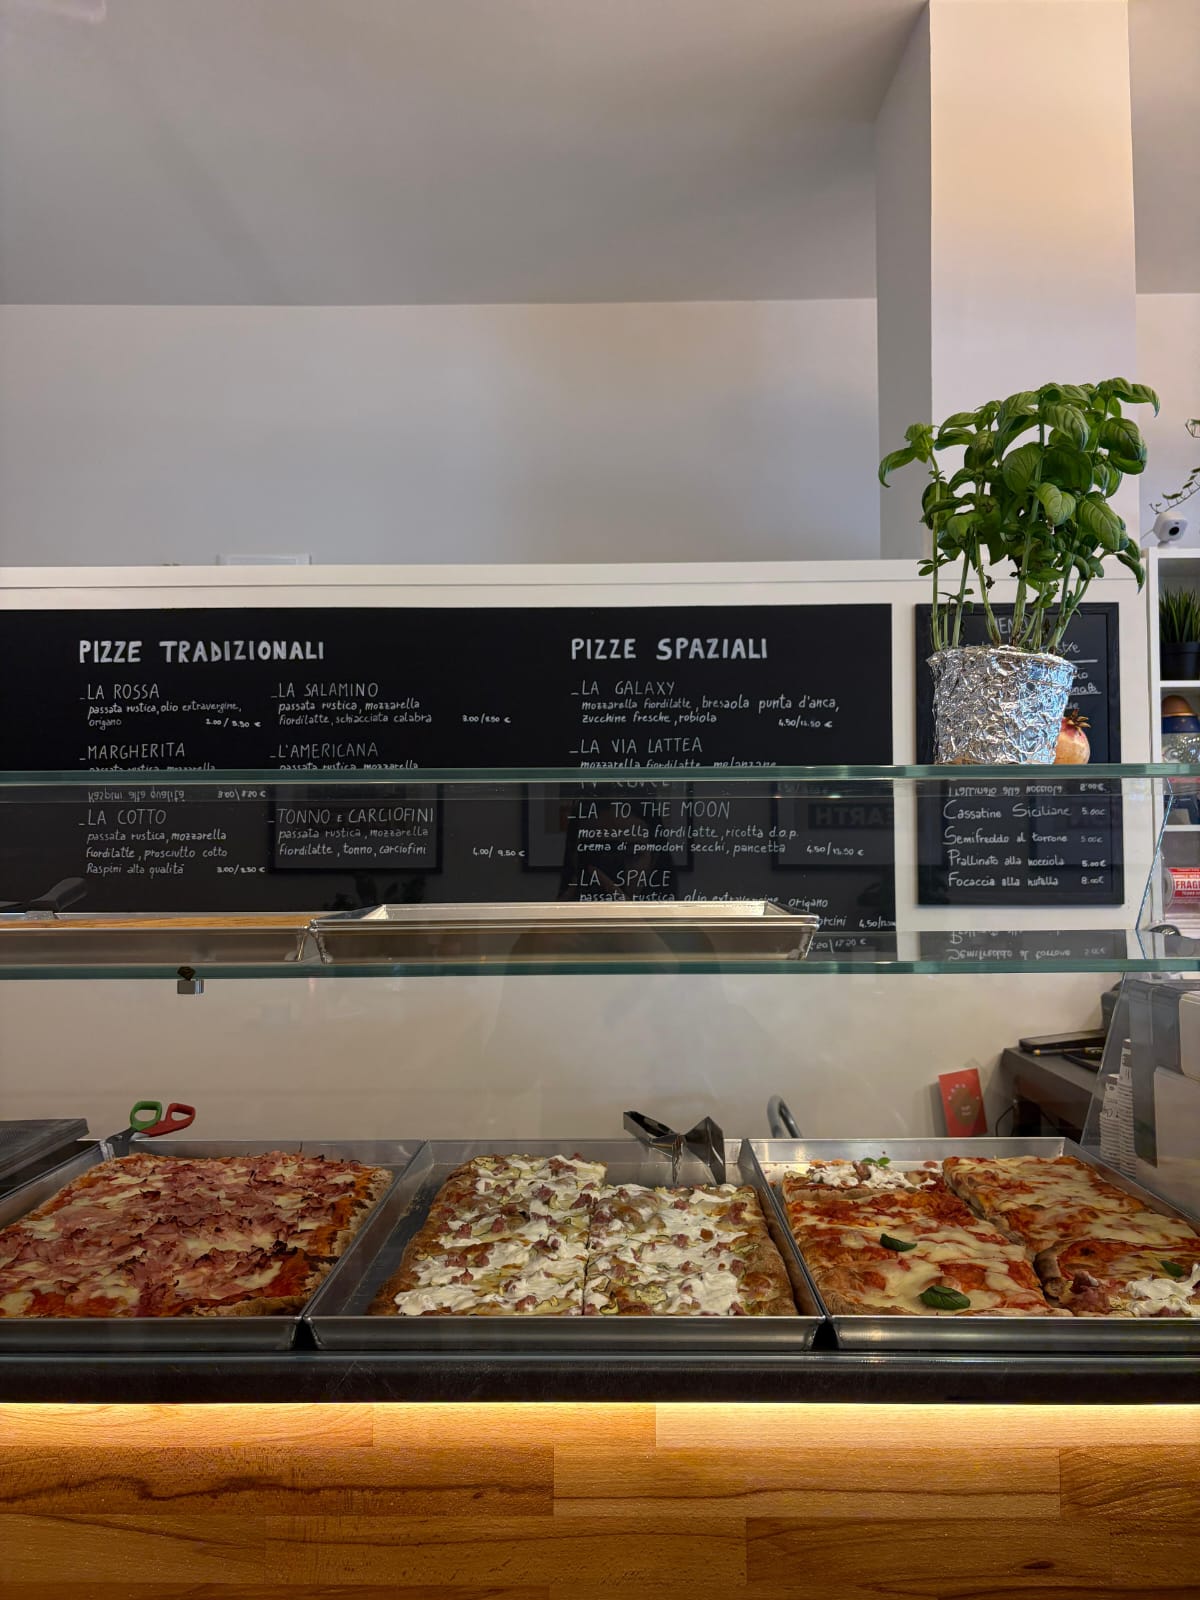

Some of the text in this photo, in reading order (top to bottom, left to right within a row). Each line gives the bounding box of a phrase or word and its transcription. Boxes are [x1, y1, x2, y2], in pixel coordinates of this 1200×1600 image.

[79, 640, 324, 663] PIZZE TRADIZIONALI
[571, 638, 768, 660] PIZZE SPAZIALI
[114, 683, 160, 699] ROSSA
[304, 682, 379, 698] SALAMINO
[615, 680, 675, 695] GALAXY
[88, 702, 123, 719] passata
[161, 702, 178, 712] olio
[279, 701, 316, 714] passata
[365, 699, 420, 710] mozzarella
[582, 697, 637, 710] mozzarella
[702, 695, 749, 709] bresaola
[758, 694, 792, 713] punta
[89, 717, 122, 730] origano
[335, 712, 389, 725] schiacciata
[394, 712, 432, 723] calabra
[582, 713, 627, 724] zucchine
[679, 710, 717, 723] robiola
[612, 739, 637, 753] VIA
[648, 737, 703, 754] LATTEA
[117, 809, 167, 825] COTTO
[348, 807, 434, 823] CARCIOFINI
[611, 802, 631, 818] TO
[640, 801, 671, 818] THE
[681, 800, 731, 819] MOON
[943, 799, 1002, 820] Cassatine
[1012, 803, 1072, 818] Siciliane
[86, 831, 126, 844] passata
[171, 828, 227, 841] mozzarella
[278, 827, 319, 844] passata
[370, 826, 429, 838] mozzarella
[578, 826, 649, 839] mozzarella
[726, 825, 763, 838] ricotta
[943, 826, 1010, 846] Semifreddo
[1016, 831, 1027, 842] al
[1032, 834, 1068, 842] torrone
[144, 847, 196, 860] prosciutto
[202, 847, 228, 857] cotto
[379, 843, 426, 855] carciofini
[577, 843, 611, 852] crema
[617, 841, 627, 851] di
[633, 841, 685, 854] pomodori
[733, 841, 786, 857] pancetta
[947, 850, 998, 865] Prallinato
[1004, 855, 1022, 865] alla
[86, 863, 122, 875] Raspini
[127, 863, 145, 874] alta
[616, 870, 671, 886] SPACE
[948, 872, 995, 887] Focaccia
[1001, 876, 1020, 886] alla
[789, 898, 828, 911] origano
